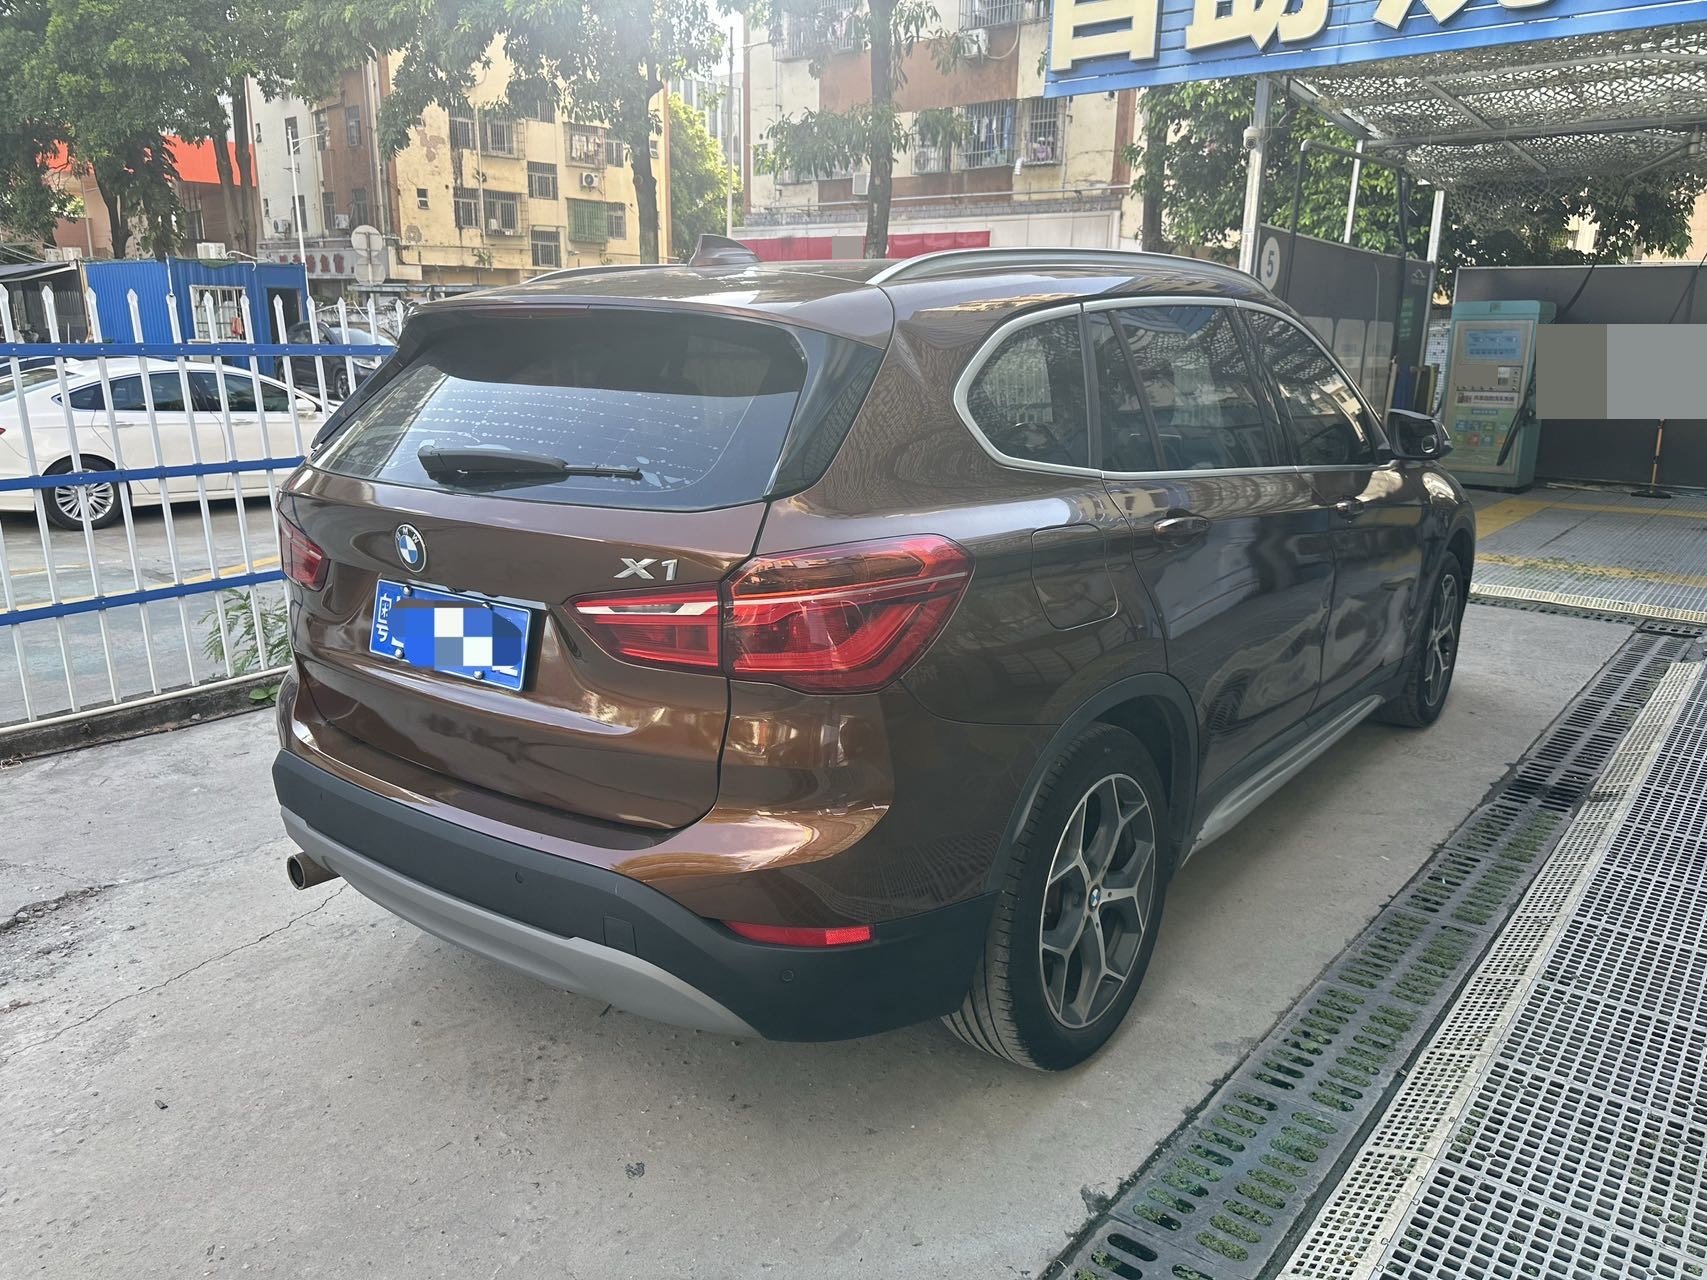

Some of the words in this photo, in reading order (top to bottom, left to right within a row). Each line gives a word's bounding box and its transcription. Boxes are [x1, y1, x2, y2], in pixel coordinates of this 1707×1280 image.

[1266, 250, 1275, 278] 5
[395, 526, 420, 544] BMW
[613, 557, 679, 581] X1
